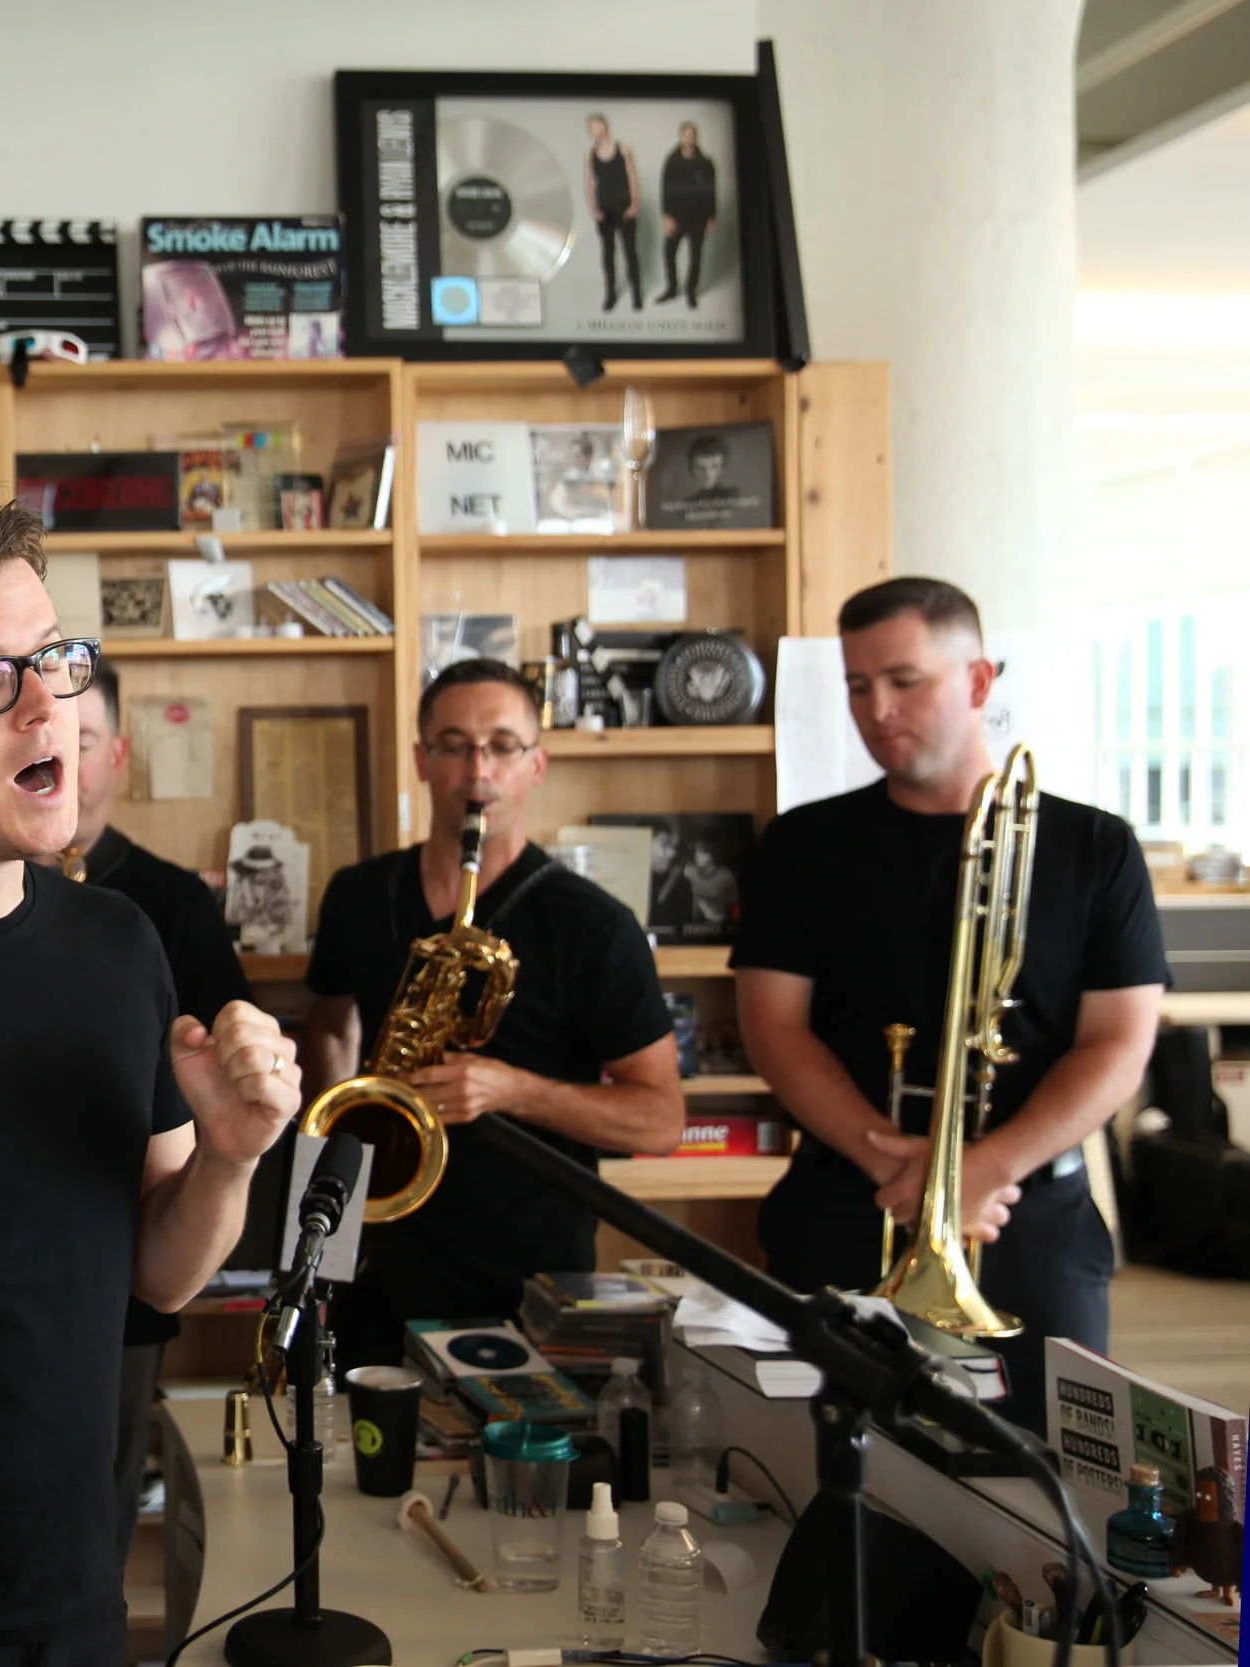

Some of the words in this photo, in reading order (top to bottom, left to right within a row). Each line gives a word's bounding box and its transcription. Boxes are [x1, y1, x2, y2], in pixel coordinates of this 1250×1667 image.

[147, 221, 248, 253] Smoke
[251, 221, 340, 253] Alarm
[446, 439, 494, 464] MIC
[451, 494, 502, 518] NET
[1060, 1379, 1112, 1414] HUNDREDS
[1063, 1430, 1118, 1469] HUNDREDS
[1231, 1433, 1243, 1472] HAYES
